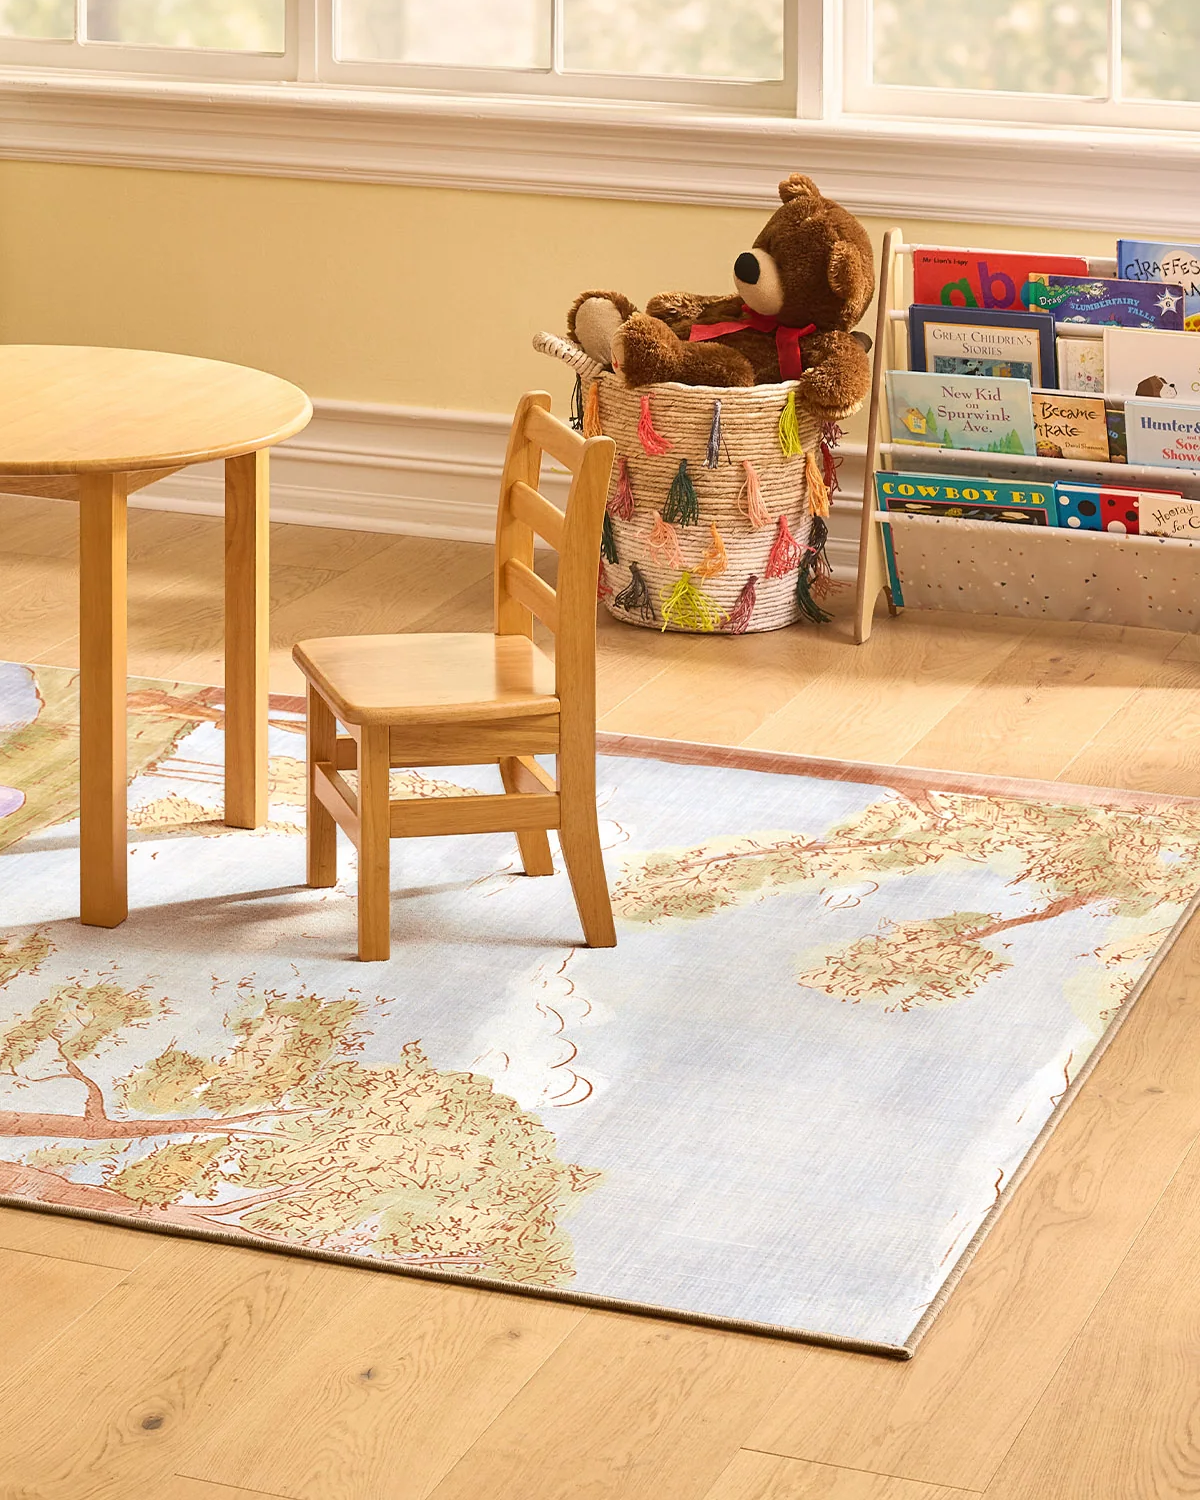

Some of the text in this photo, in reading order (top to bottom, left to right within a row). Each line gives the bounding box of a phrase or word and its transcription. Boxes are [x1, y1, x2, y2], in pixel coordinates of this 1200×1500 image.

[1125, 258, 1200, 281] GIRAFFES
[1039, 293, 1066, 306] Dragon
[1069, 297, 1140, 312] SLUMBERFAIRY
[1165, 300, 1171, 308] 6
[1127, 306, 1156, 322] FALLS
[932, 328, 1032, 346] GREAT CHILDREN'S
[962, 342, 1002, 356] STORIES
[941, 385, 1002, 401] New Kid
[937, 405, 1011, 422] Spurwink
[965, 402, 979, 410] on
[1039, 401, 1102, 420] Became
[962, 420, 993, 433] Ave.
[1140, 416, 1193, 433] Hunter
[882, 482, 1046, 505] COWBOY ED
[1152, 504, 1194, 527] Hooray
[1172, 520, 1187, 533] for
